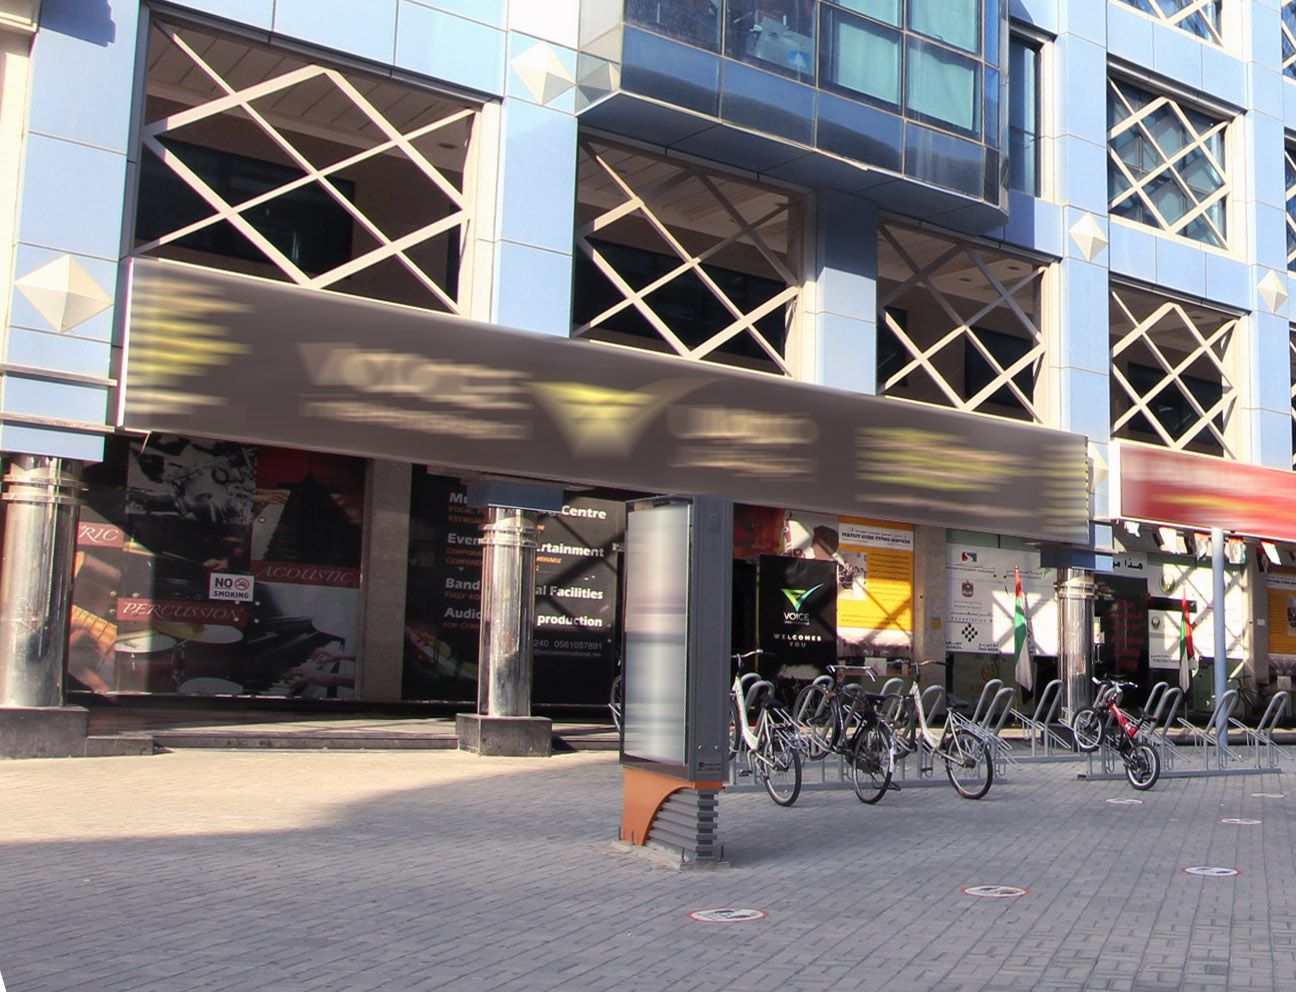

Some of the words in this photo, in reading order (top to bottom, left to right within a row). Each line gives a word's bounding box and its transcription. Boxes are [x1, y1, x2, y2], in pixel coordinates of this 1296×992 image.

[562, 504, 607, 519] Centre
[257, 566, 354, 583] ACOUSTIC
[215, 577, 233, 588] NO
[445, 578, 481, 591] Band
[549, 586, 604, 599] Facilities
[213, 590, 249, 599] SMOKING
[123, 601, 241, 620] PERCUSSION
[783, 612, 809, 621] VOICE
[537, 614, 603, 628] production
[773, 633, 822, 642] WELCOMES
